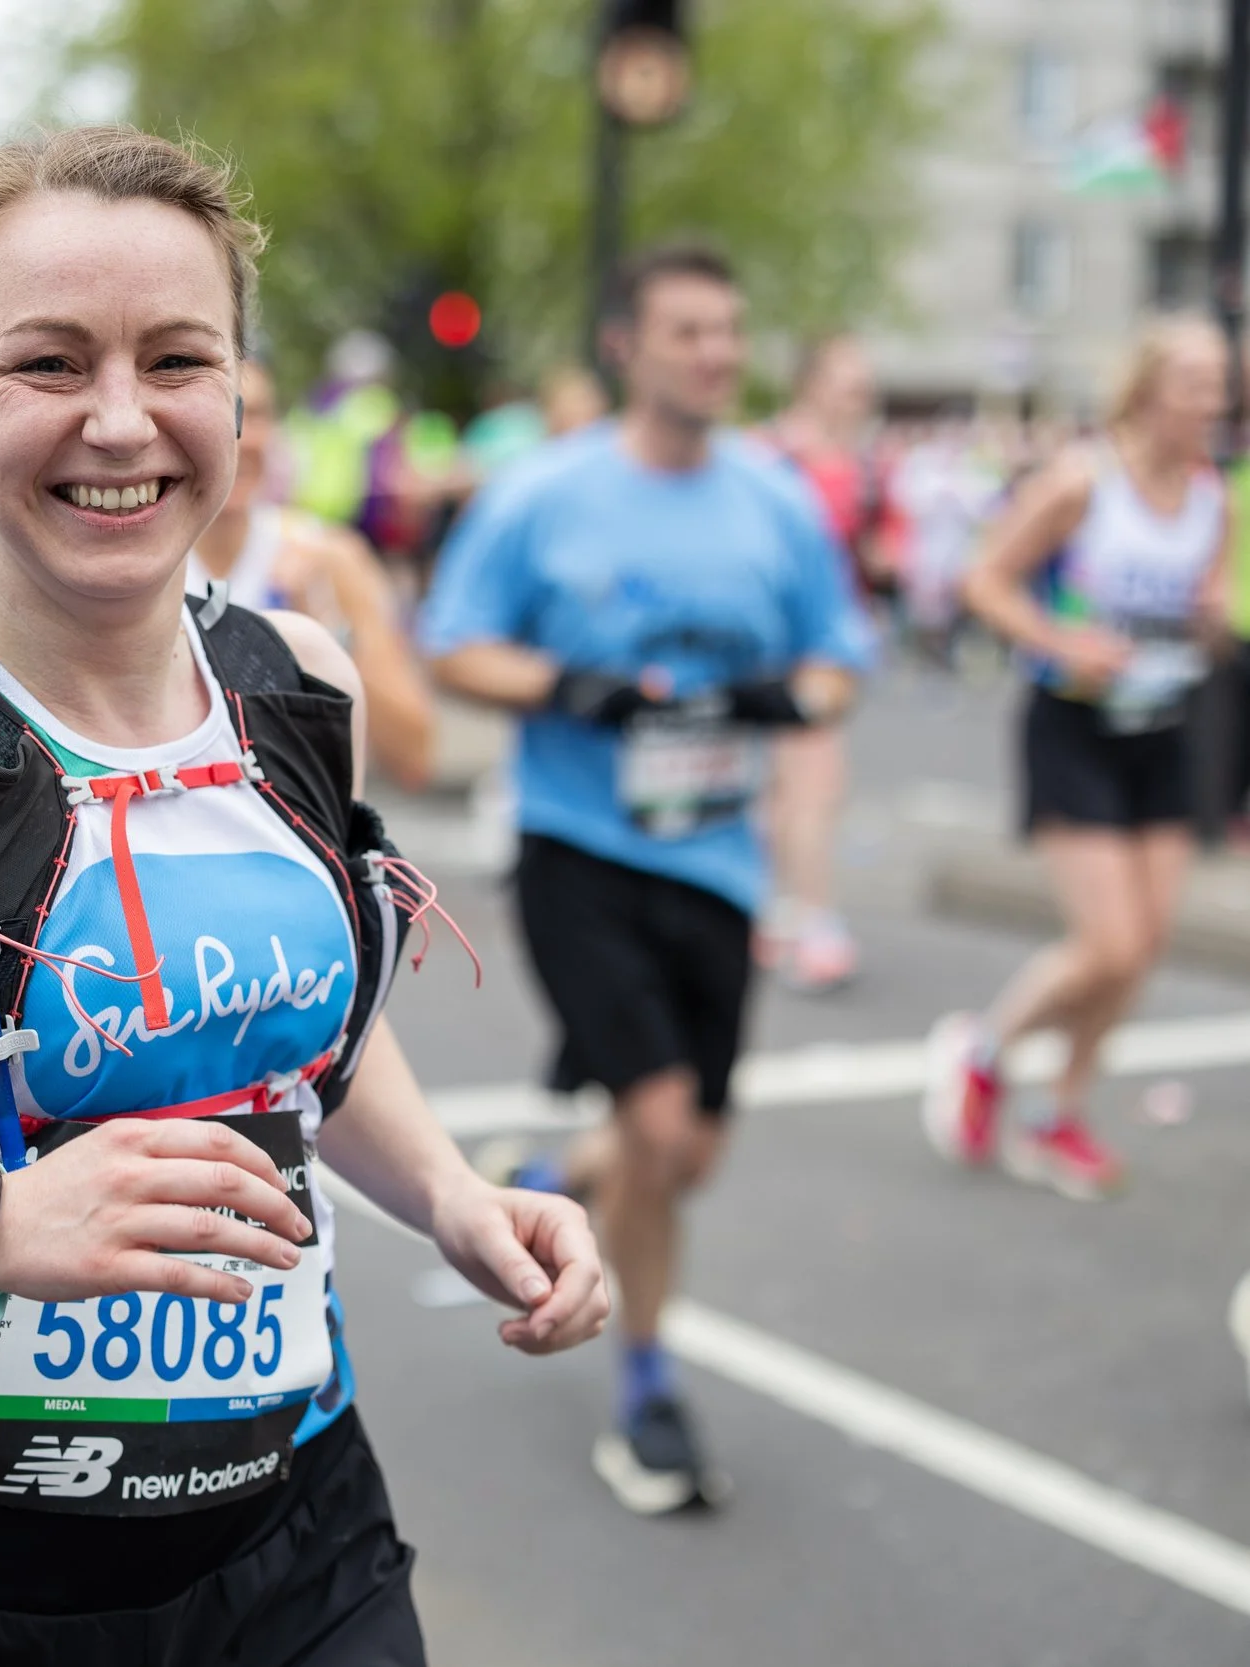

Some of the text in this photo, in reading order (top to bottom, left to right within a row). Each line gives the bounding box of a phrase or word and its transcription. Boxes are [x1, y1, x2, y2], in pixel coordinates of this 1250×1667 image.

[194, 934, 345, 1047] Ryder
[33, 1283, 285, 1382] 58085
[43, 1398, 88, 1411] MEDAL
[121, 1451, 280, 1499] new balance
